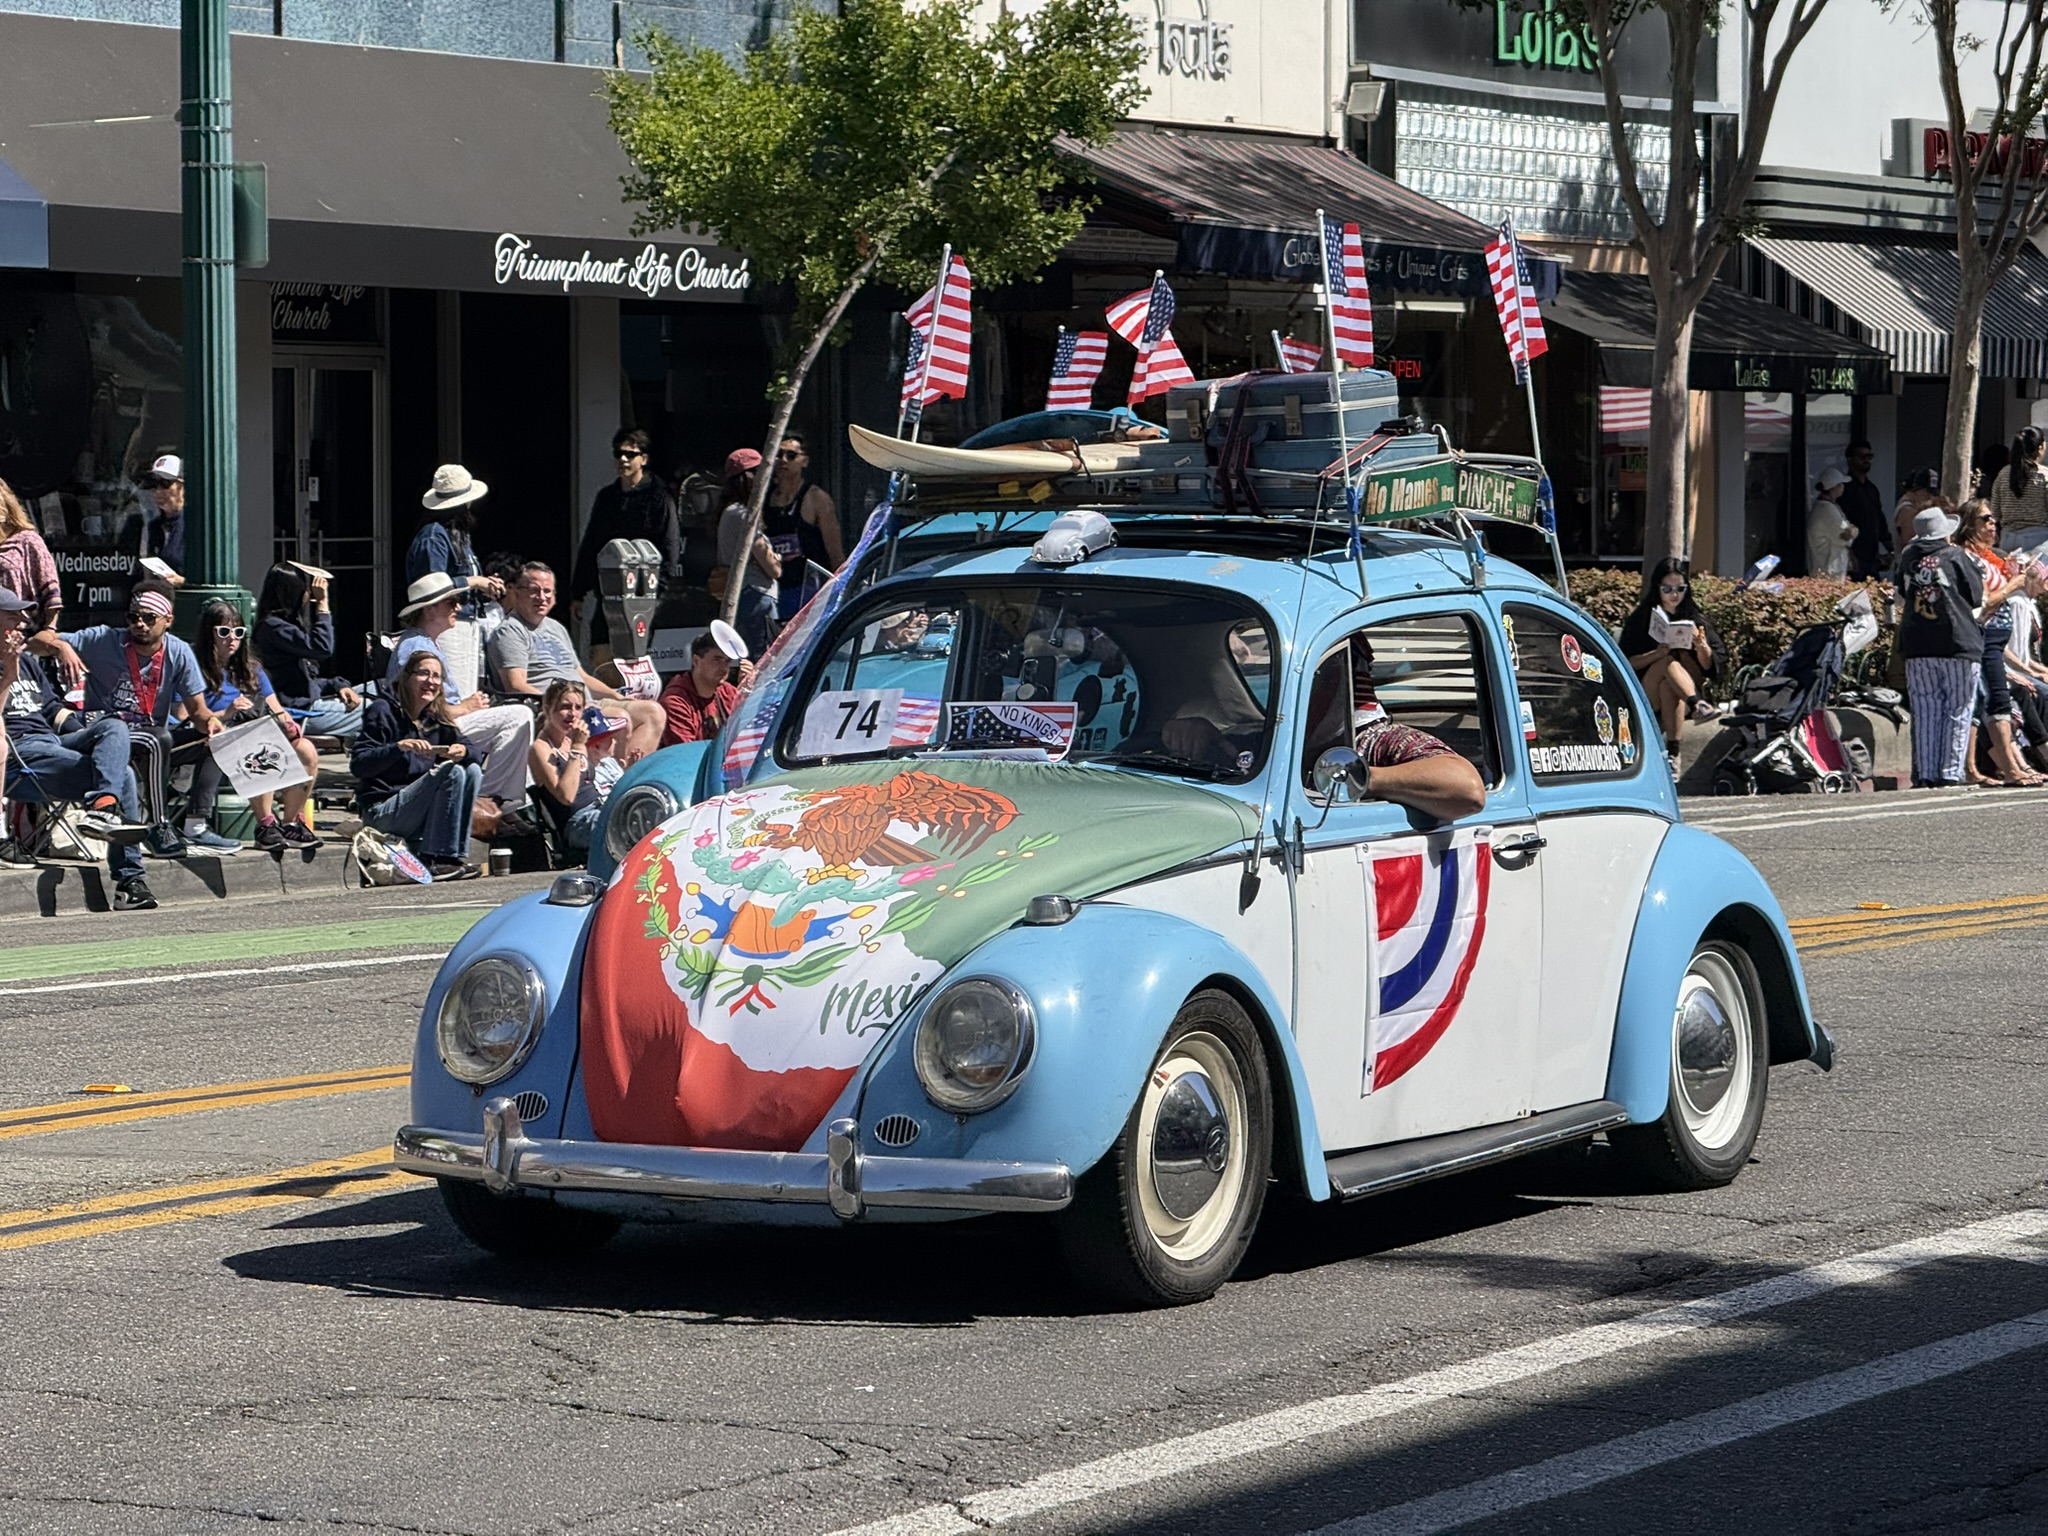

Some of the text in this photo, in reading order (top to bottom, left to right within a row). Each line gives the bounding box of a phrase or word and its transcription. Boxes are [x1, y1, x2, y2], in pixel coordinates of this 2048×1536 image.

[495, 232, 751, 298] Triumphant Life Church
[1397, 250, 1436, 285] Unique
[1439, 254, 1469, 283] Gifts
[272, 300, 331, 330] Church
[1365, 481, 1387, 515] No
[1390, 476, 1439, 512] Mames
[1458, 469, 1532, 520] PINCHE WAY
[52, 550, 136, 576] Wednesday
[76, 582, 112, 608] 7 pm
[835, 700, 881, 740] 74
[999, 705, 1058, 740] NO KINGS
